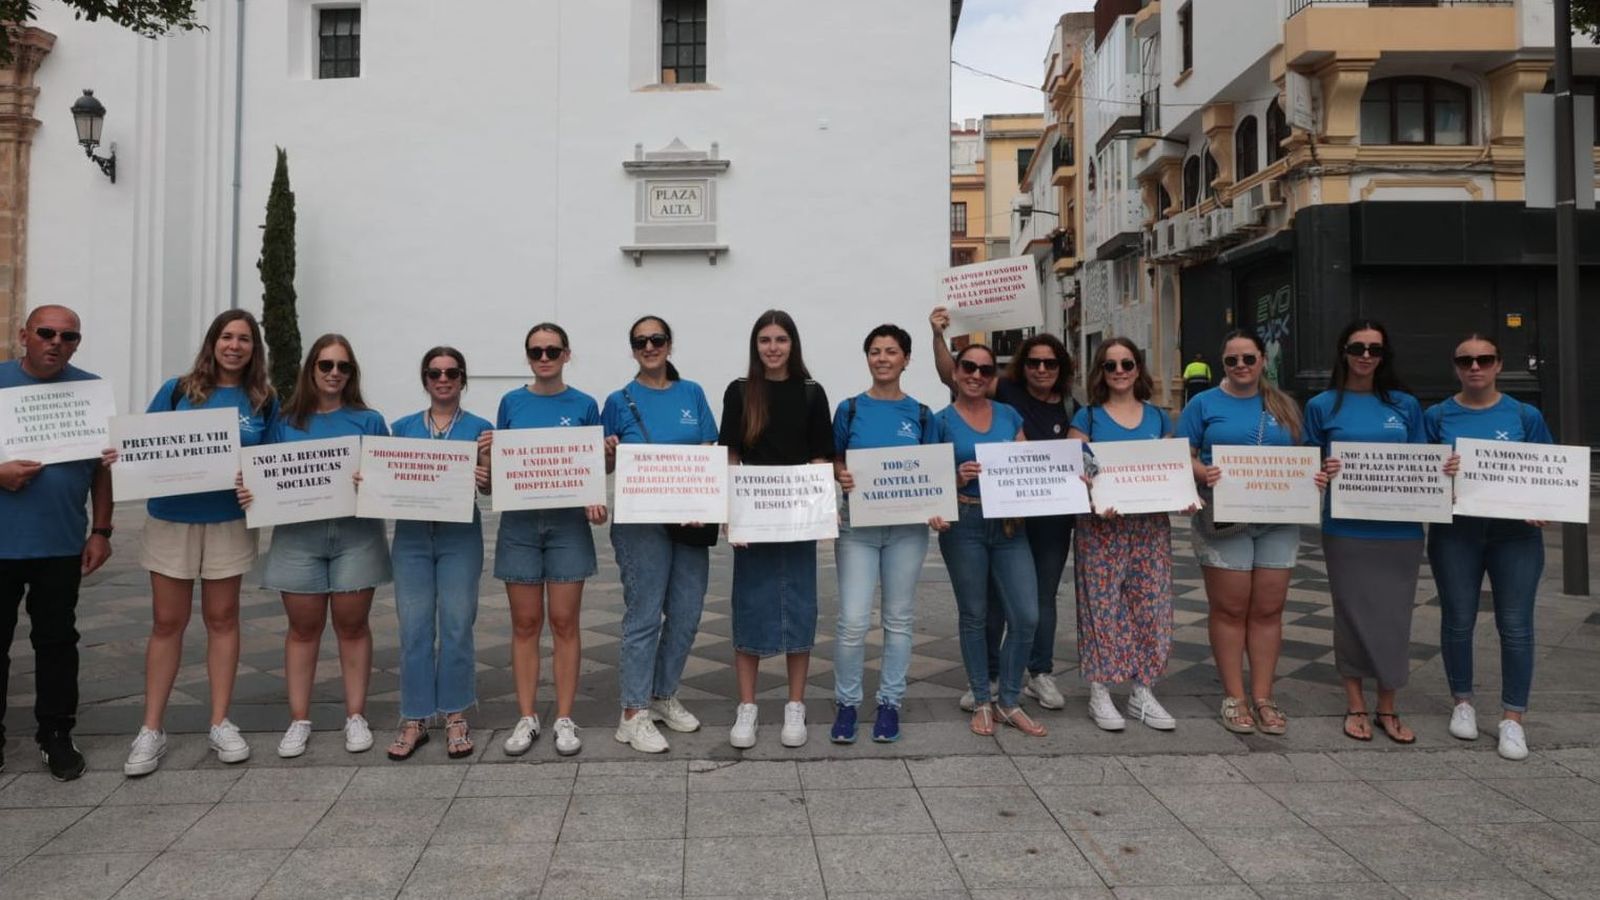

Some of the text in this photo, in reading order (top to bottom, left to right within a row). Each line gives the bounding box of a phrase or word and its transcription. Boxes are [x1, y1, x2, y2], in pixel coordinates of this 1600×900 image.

[656, 189, 697, 200] PLAZA
[661, 204, 691, 215] ALTA
[961, 271, 983, 280] APOYO
[970, 275, 1023, 288] ASOCIACIONES
[947, 292, 967, 301] PARA
[958, 300, 967, 308] DE
[970, 298, 983, 306] LAS
[17, 409, 87, 424] INMEDIATA DE
[25, 419, 87, 433] LA LEY DE LA
[5, 427, 107, 446] JUSTICIA UNIVERSAL
[122, 431, 229, 449] PREVIENE EL VIH
[121, 445, 232, 463] ¡HAZTE LA PRUEBA!
[501, 444, 594, 456] NO AL CIERRE DE LA
[1340, 451, 1360, 460] ¡NO!
[1363, 452, 1369, 460] A
[1372, 452, 1384, 460] LA
[1475, 448, 1568, 463] UNÁMONOS A LA
[252, 447, 350, 466] ¡NO! AL RECORTE
[523, 457, 573, 467] UNIDAD DE
[655, 454, 684, 462] APOYO
[1008, 453, 1051, 464] CENTROS
[1220, 455, 1312, 465] ALTERNATIVAS DE
[264, 461, 342, 478] DE POLÍTICAS
[387, 462, 448, 471] ENFERMOS DE
[637, 465, 692, 473] PROGRAMAS
[881, 460, 920, 471] TOD@S
[987, 464, 1075, 476] ESPECÍFICOS PARA
[1101, 462, 1184, 474] ARCOTRAFICANTES
[1345, 462, 1438, 473] DE PLAZAS PARA LA
[1478, 461, 1565, 475] LUCHA POR UN
[734, 474, 792, 484] PATOLOGÍA
[1228, 469, 1305, 478] OCIO PARA LOS
[276, 476, 332, 490] SOCIALES
[514, 479, 584, 491] HOSPITALARIA
[704, 476, 718, 484] DE
[873, 474, 931, 487] CONTRA EL
[998, 476, 1068, 488] LOS ENFERMOS
[1122, 476, 1134, 484] LA
[1427, 475, 1440, 484] DE
[1463, 472, 1579, 487] MUNDO SIN DROGAS
[622, 486, 720, 495] DROGODEPENDENCIAS
[736, 487, 750, 497] UN
[753, 486, 809, 497] PROBLEMA
[1016, 488, 1052, 498] DUALES
[1338, 484, 1444, 494] DROGODEPENDIENTES
